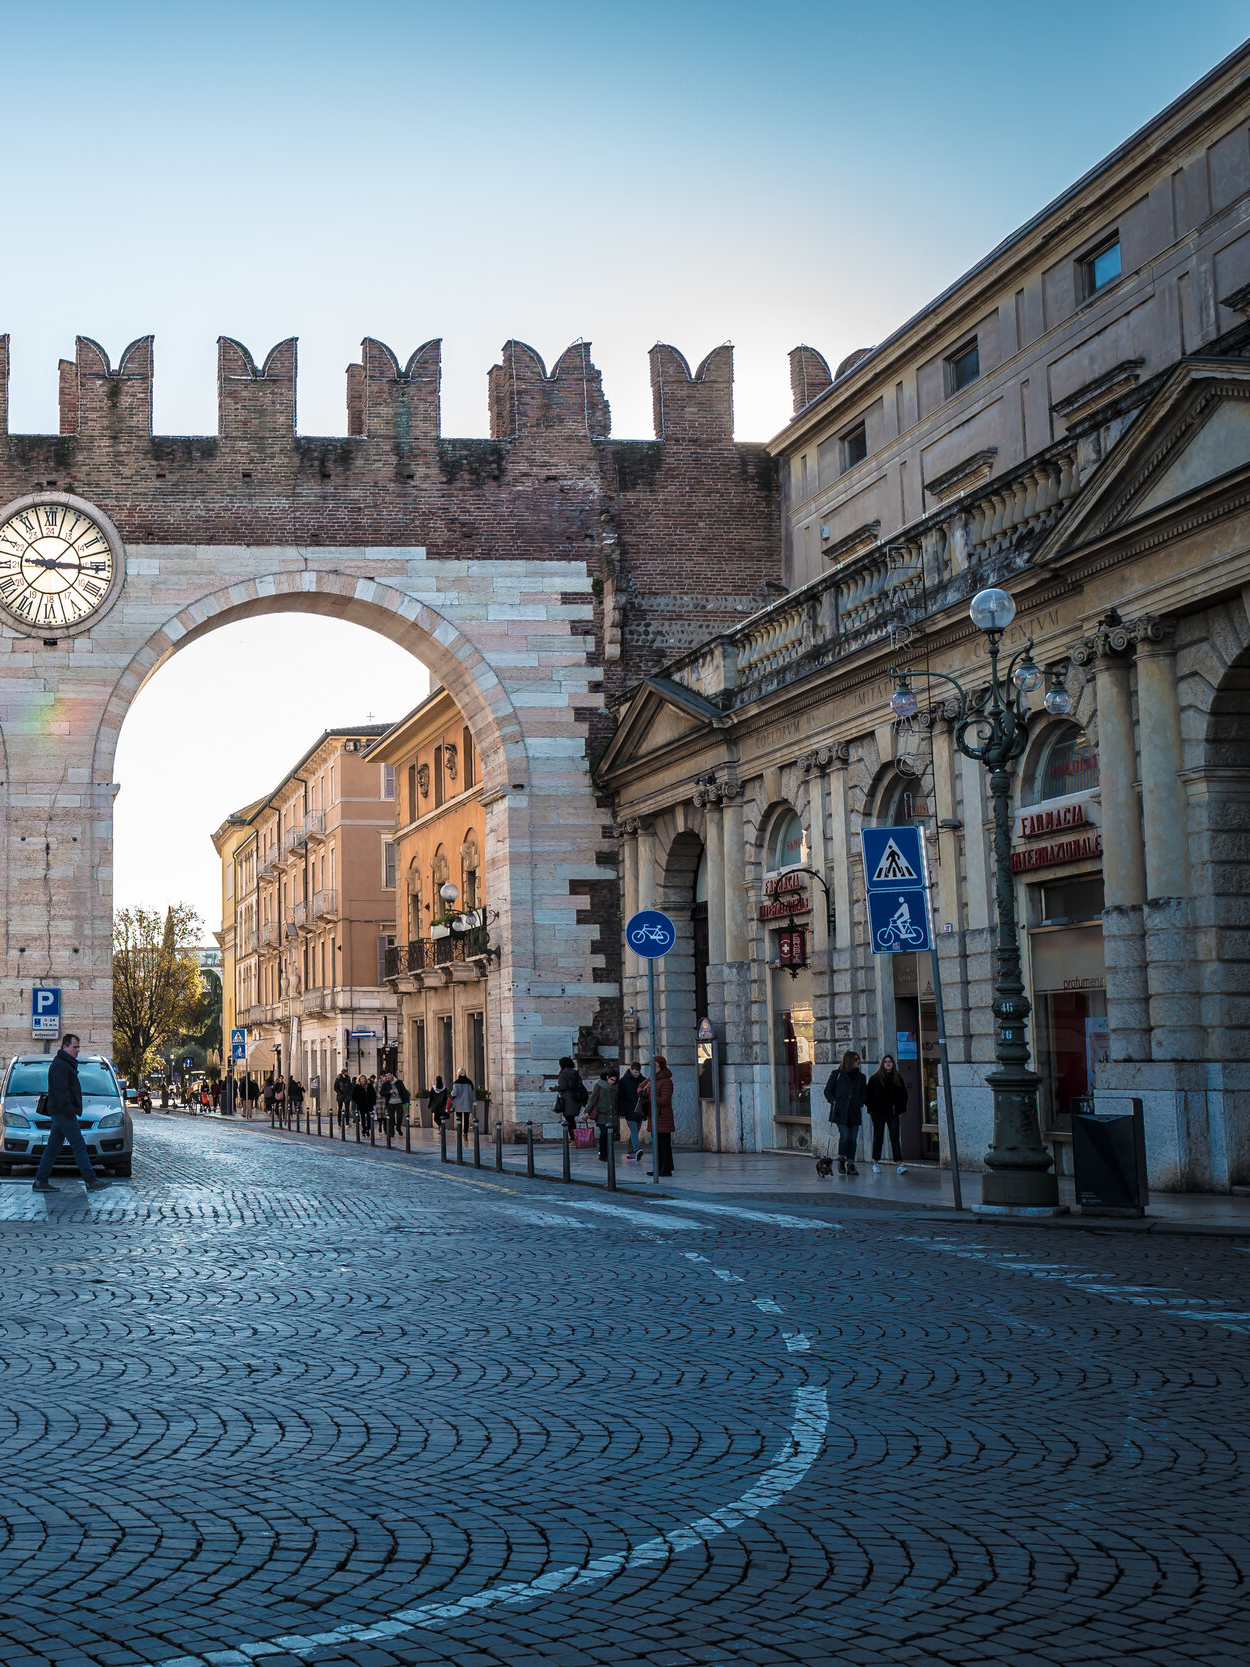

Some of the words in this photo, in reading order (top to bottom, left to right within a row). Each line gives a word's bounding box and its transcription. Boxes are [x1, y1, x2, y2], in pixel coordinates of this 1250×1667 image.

[44, 511, 58, 526] XII
[28, 531, 38, 540] 23
[45, 528, 55, 536] 24
[65, 533, 72, 541] 13
[77, 544, 85, 552] 14
[12, 561, 20, 569] 21
[15, 578, 25, 587] 20
[29, 590, 38, 599] 19
[64, 592, 72, 600] 17
[46, 596, 54, 604] 18
[1021, 805, 1084, 835] FARMACIA
[1011, 835, 1102, 870] INTERNAZIONALE
[1063, 977, 1104, 990] profumeria
[37, 991, 54, 1013] P
